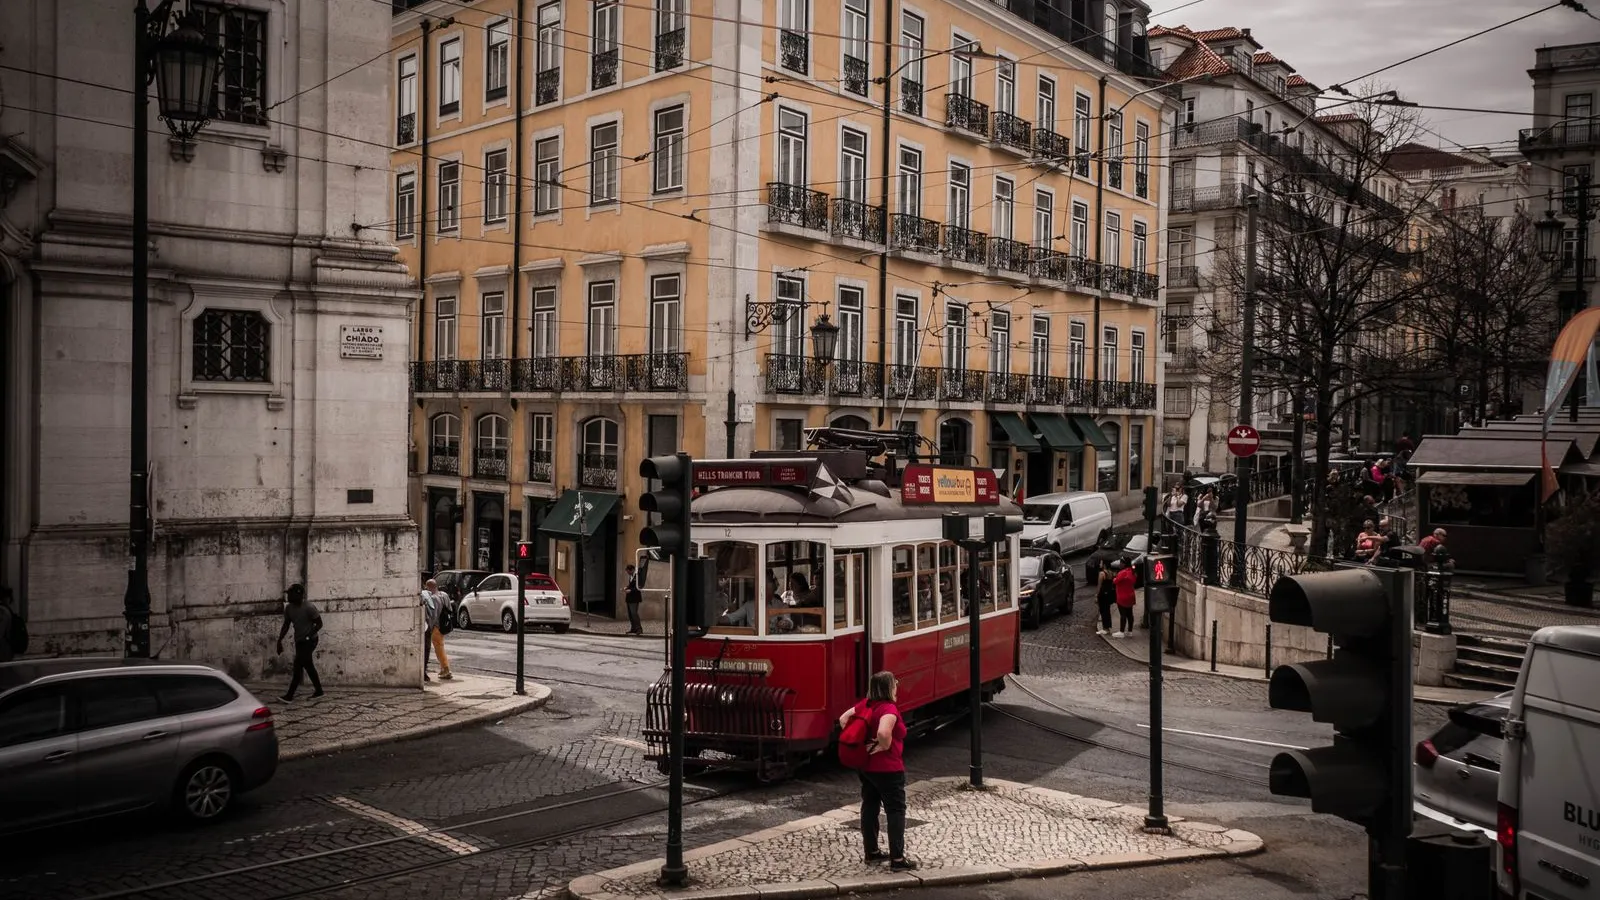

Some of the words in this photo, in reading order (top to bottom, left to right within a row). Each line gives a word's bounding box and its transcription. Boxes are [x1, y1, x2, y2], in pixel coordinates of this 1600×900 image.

[1460, 385, 1469, 395] P
[698, 471, 716, 480] HILLS
[744, 470, 761, 479] TOUR
[724, 528, 732, 537] 12
